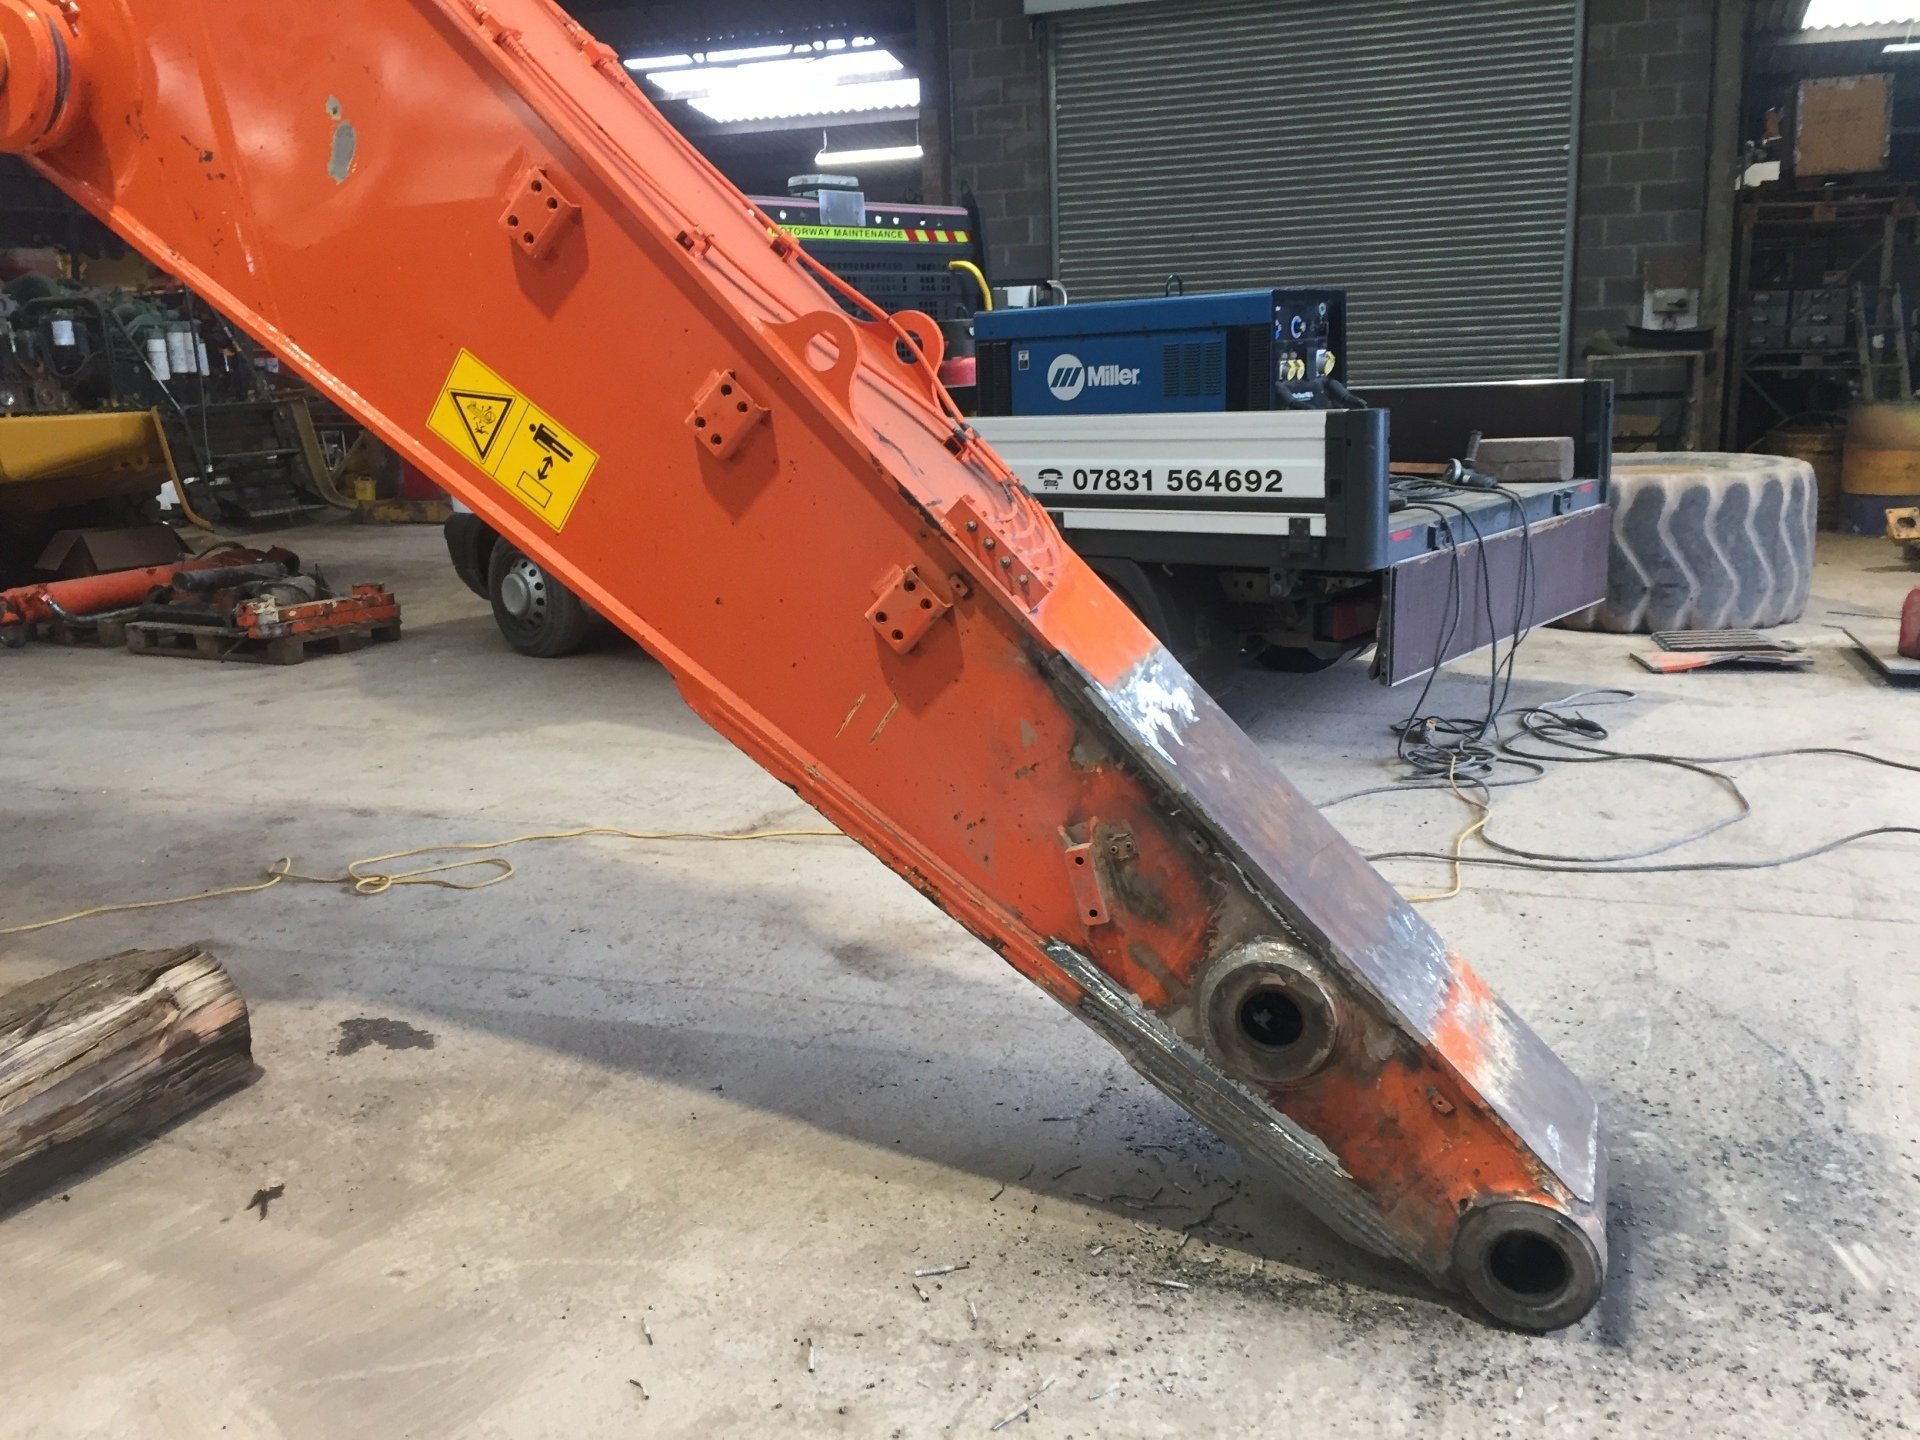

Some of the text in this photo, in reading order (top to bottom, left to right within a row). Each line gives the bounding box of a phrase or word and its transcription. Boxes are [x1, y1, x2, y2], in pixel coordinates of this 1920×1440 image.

[833, 228, 903, 239] MAINTENANCE
[1087, 364, 1140, 387] Miller
[1073, 469, 1283, 493] 07831 564692
